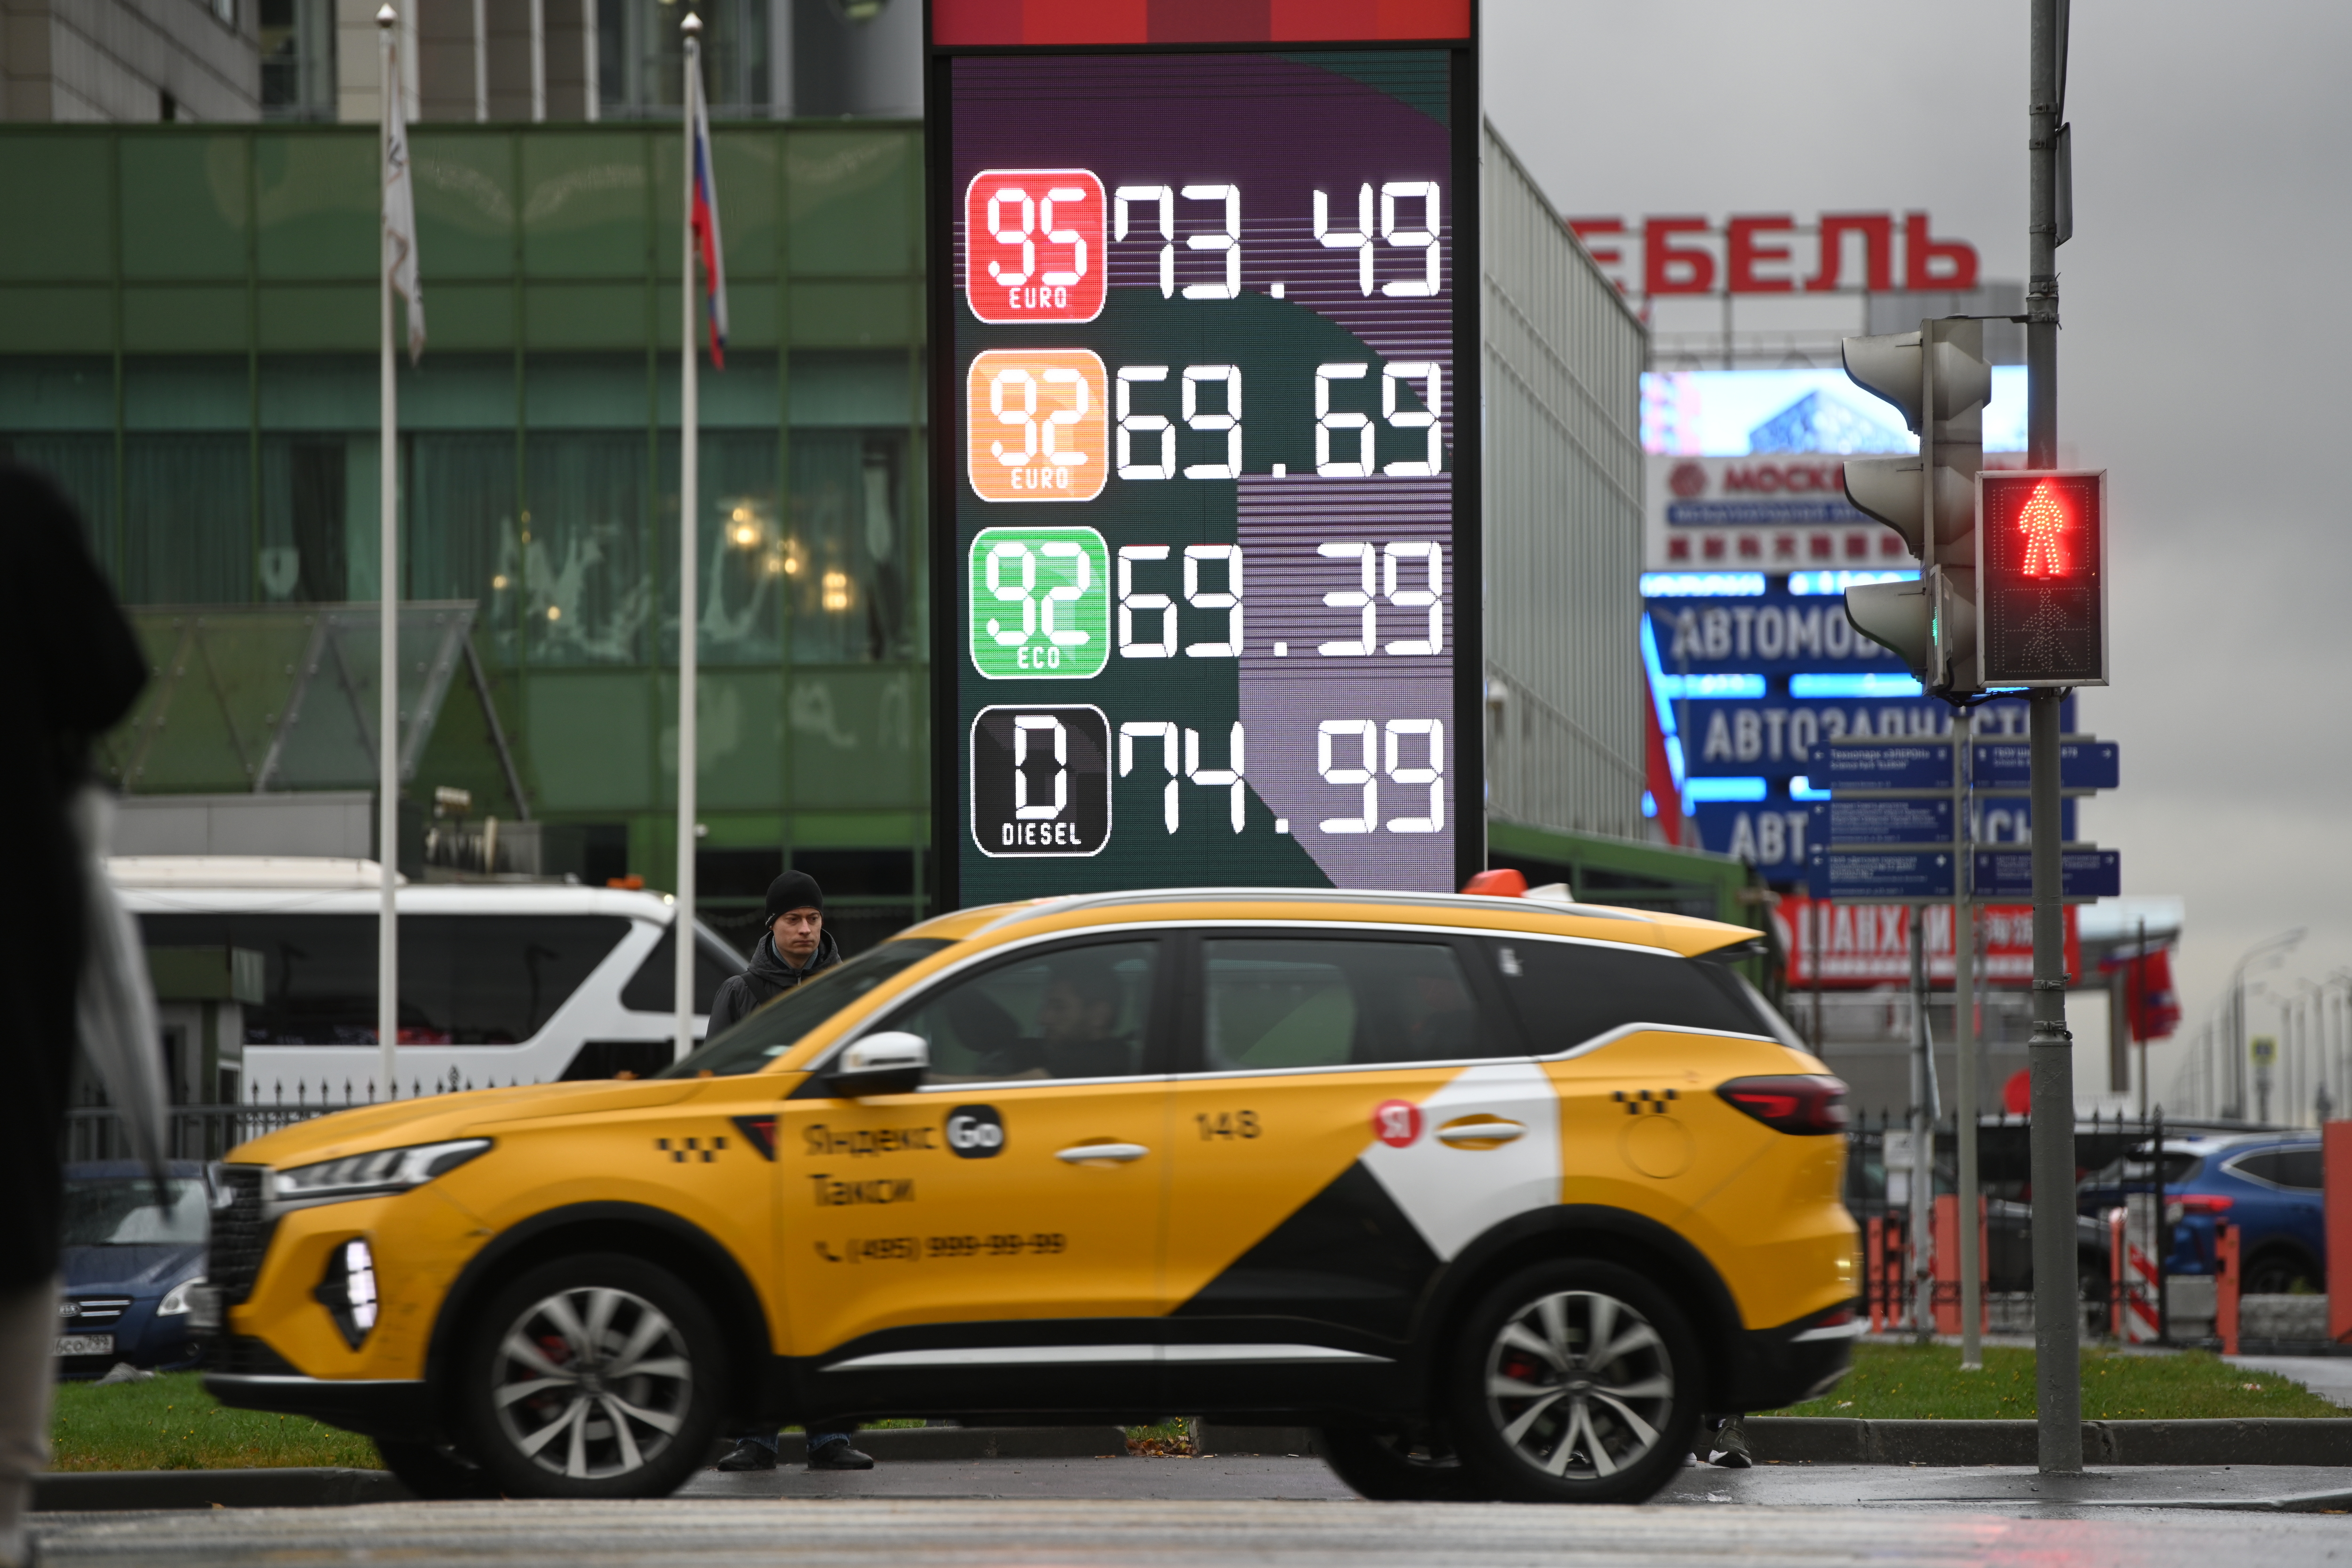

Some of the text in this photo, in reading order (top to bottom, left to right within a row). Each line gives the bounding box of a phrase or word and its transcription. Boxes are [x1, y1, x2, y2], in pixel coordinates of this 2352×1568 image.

[987, 182, 1440, 299] 95 73.49
[1009, 287, 1067, 309] EURO
[990, 361, 1441, 480] 92 69.69
[1010, 468, 1069, 489] EURO
[986, 540, 1442, 658] 92 69.39
[1017, 646, 1060, 669] ECO
[1015, 715, 1444, 835] D 74.99
[1002, 822, 1082, 845] DIESEL
[946, 1116, 1004, 1148] Go
[810, 1174, 916, 1206] Такси
[925, 1233, 1067, 1258] 999-99-99
